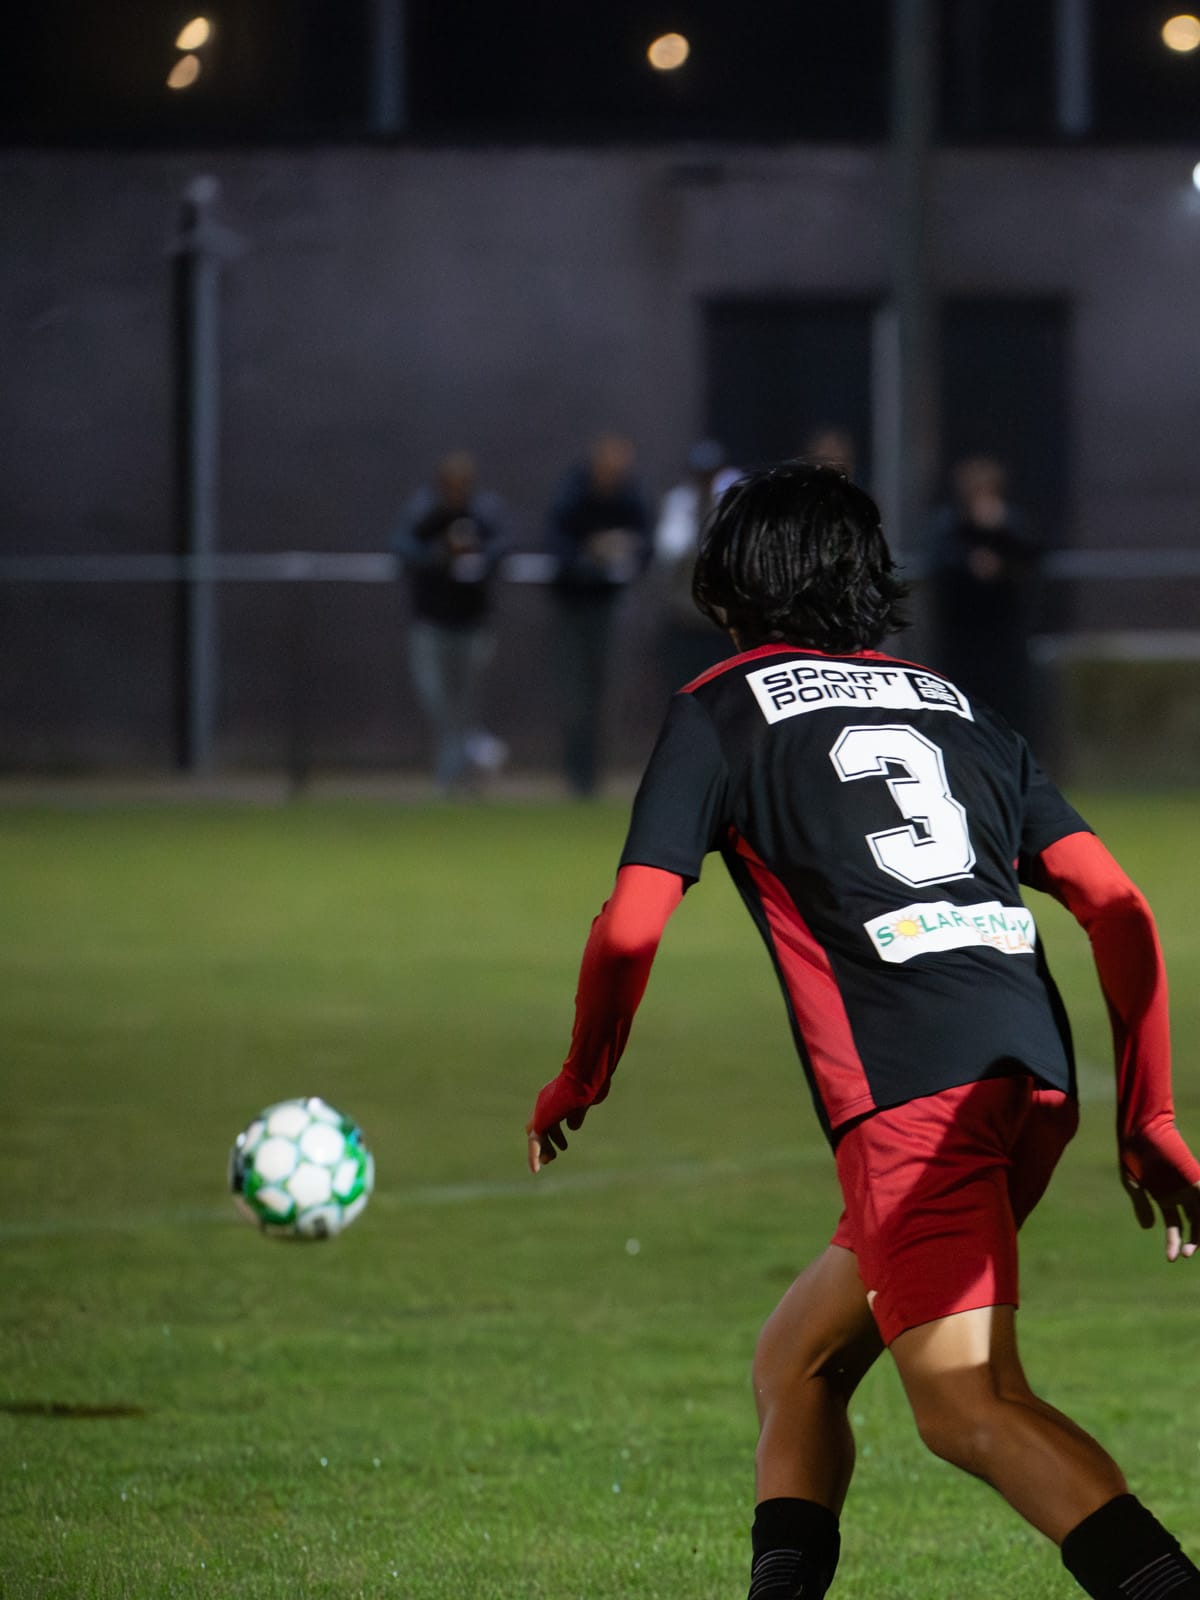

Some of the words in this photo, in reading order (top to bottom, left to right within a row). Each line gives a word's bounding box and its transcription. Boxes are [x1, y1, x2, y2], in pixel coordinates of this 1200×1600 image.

[762, 667, 898, 693] SPORT
[770, 684, 878, 711] POINT
[828, 724, 977, 888] 3
